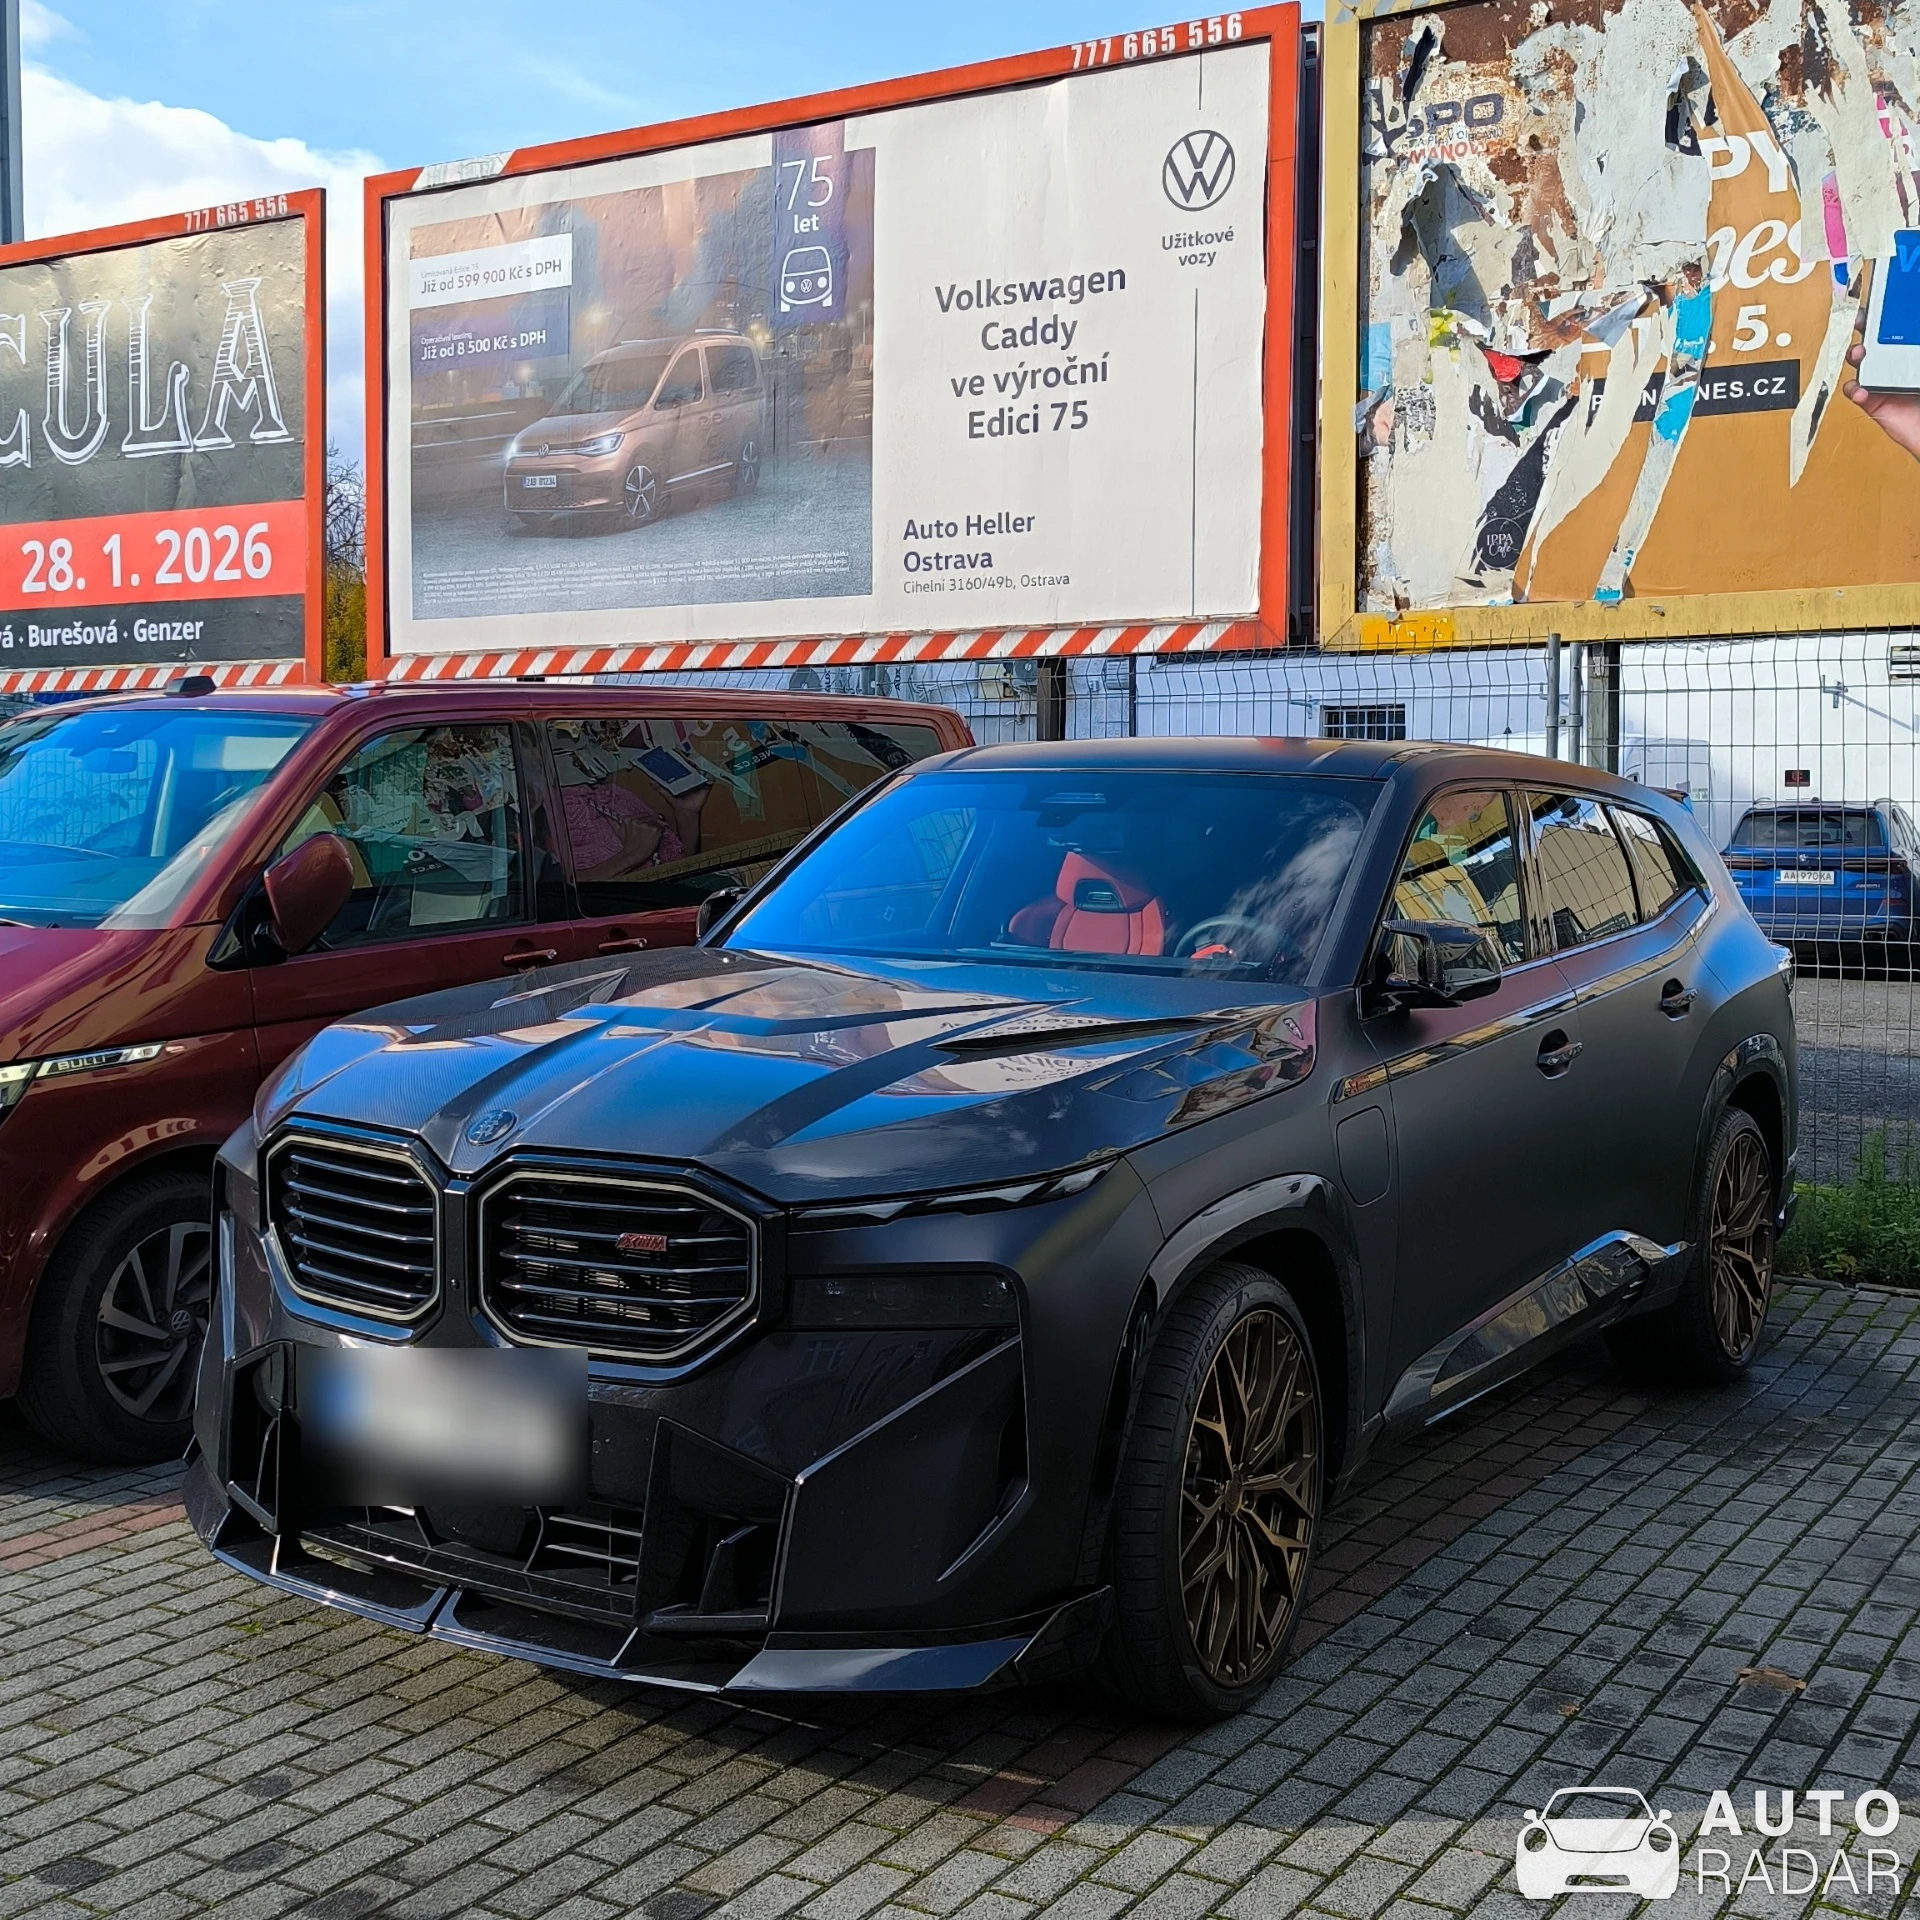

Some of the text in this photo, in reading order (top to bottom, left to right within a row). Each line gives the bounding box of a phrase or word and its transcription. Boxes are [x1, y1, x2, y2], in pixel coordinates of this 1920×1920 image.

[1070, 12, 1244, 69] 777 665 556
[782, 155, 834, 210] 75
[184, 194, 288, 232] 777 665 556
[793, 214, 820, 234] let
[1161, 226, 1235, 251] Užitkové
[1178, 248, 1217, 267] vozy
[421, 259, 562, 294] Již od 599 900 Kč s DPH
[934, 267, 1127, 313] Volkswagen
[421, 330, 546, 361] Již od 8 500 Kč s DPH
[981, 315, 1078, 352] Caddy
[951, 352, 1110, 398] ve výroční
[967, 400, 1089, 440] Edici 75
[903, 512, 1036, 541] Auto Heller
[21, 522, 273, 593] 28. 1. 2026
[903, 548, 994, 572] Ostrava
[902, 572, 1070, 594] Cihelní 3160/49b, Ostrava
[27, 619, 119, 647] Burešová
[133, 618, 204, 643] Genzer
[57, 1056, 106, 1071] BULLI
